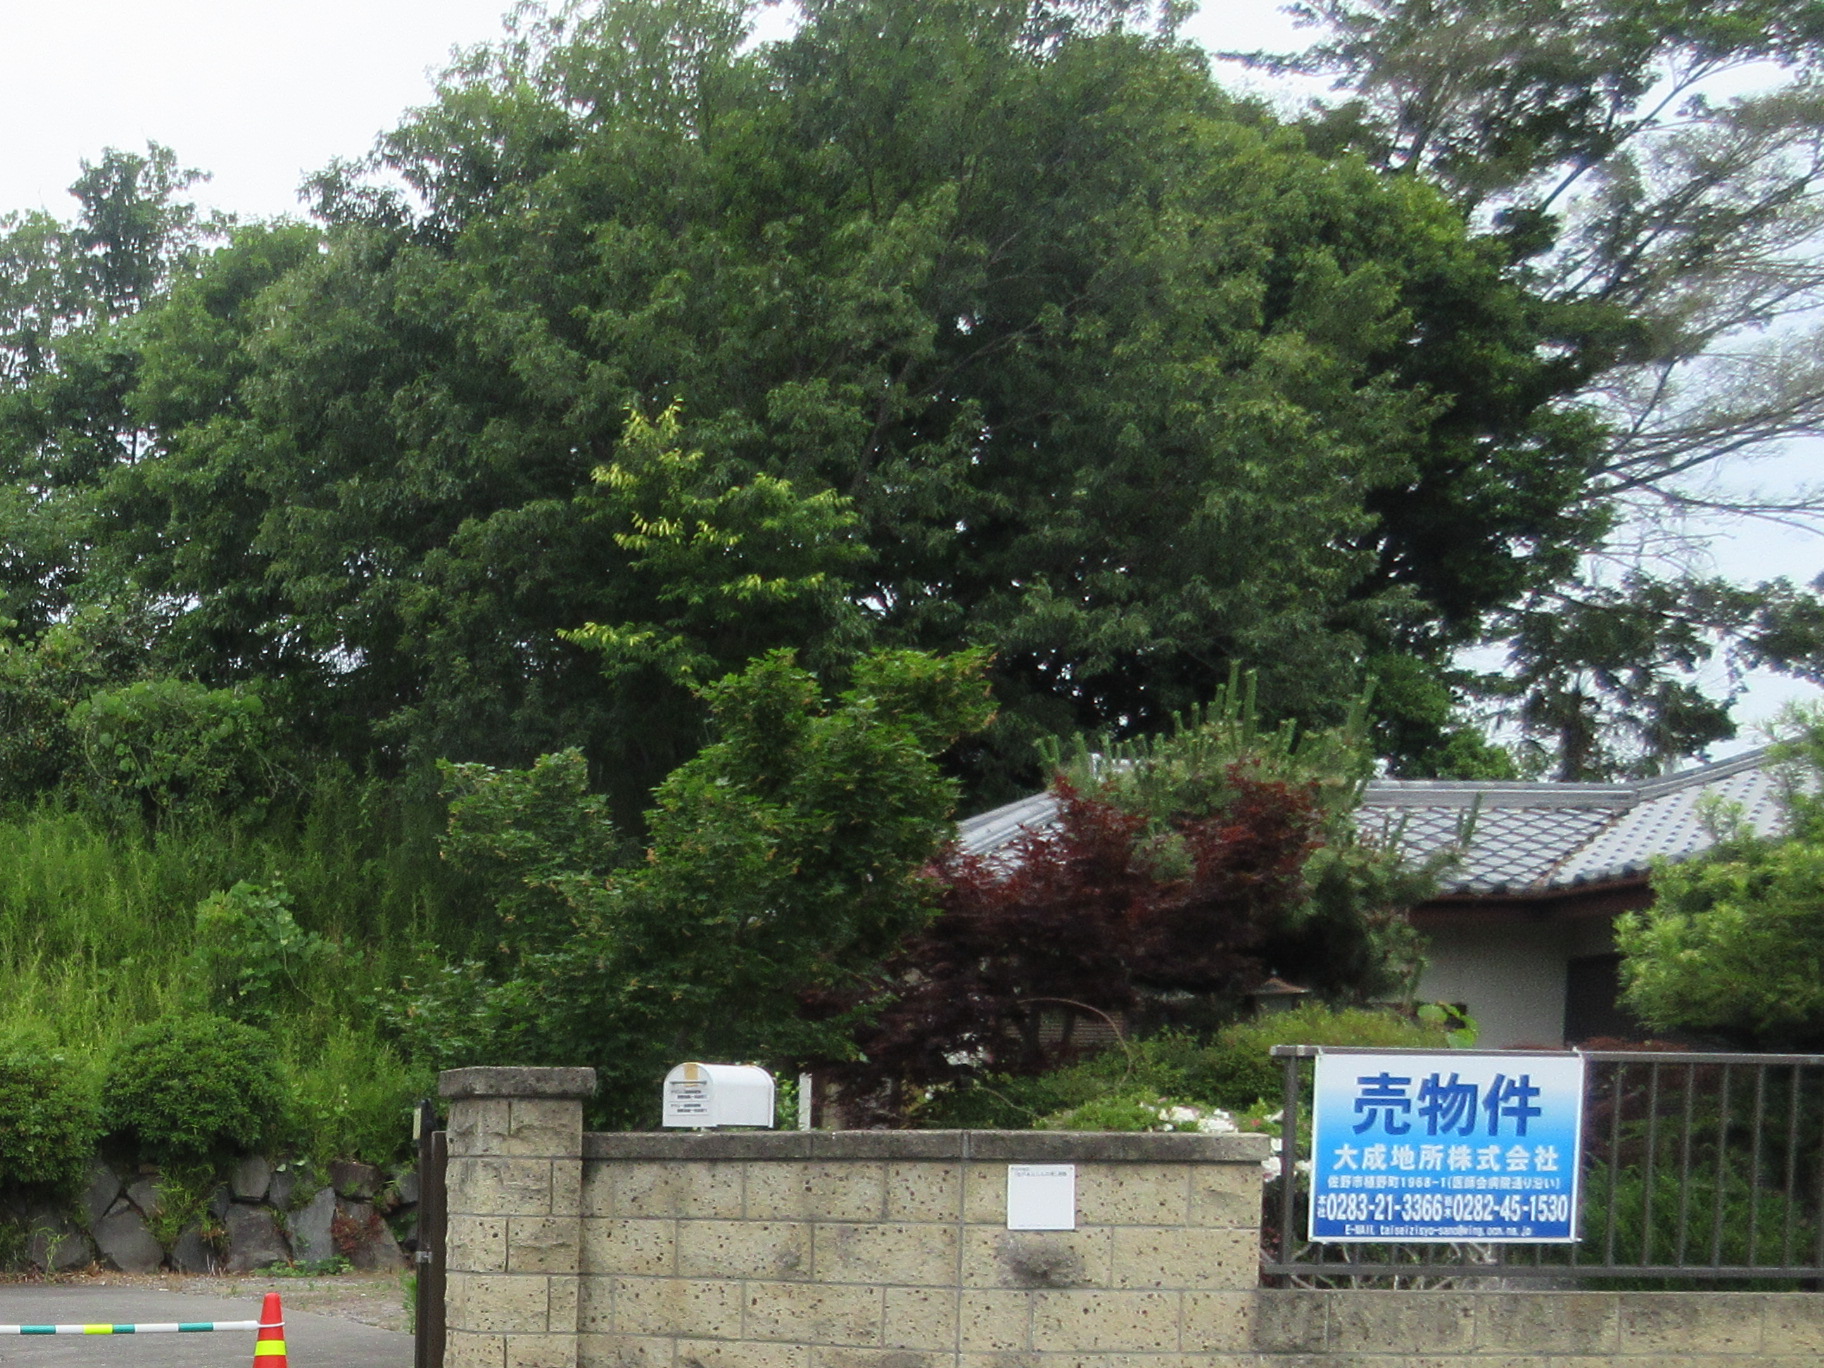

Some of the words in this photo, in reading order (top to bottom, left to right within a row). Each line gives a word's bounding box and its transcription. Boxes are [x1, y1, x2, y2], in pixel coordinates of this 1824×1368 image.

[1352, 1072, 1542, 1137] 売物件
[1332, 1143, 1559, 1172] 大成地所株式会社
[1326, 1193, 1443, 1221] 0283-21-3366
[1453, 1193, 1569, 1222] 0282-45-1530
